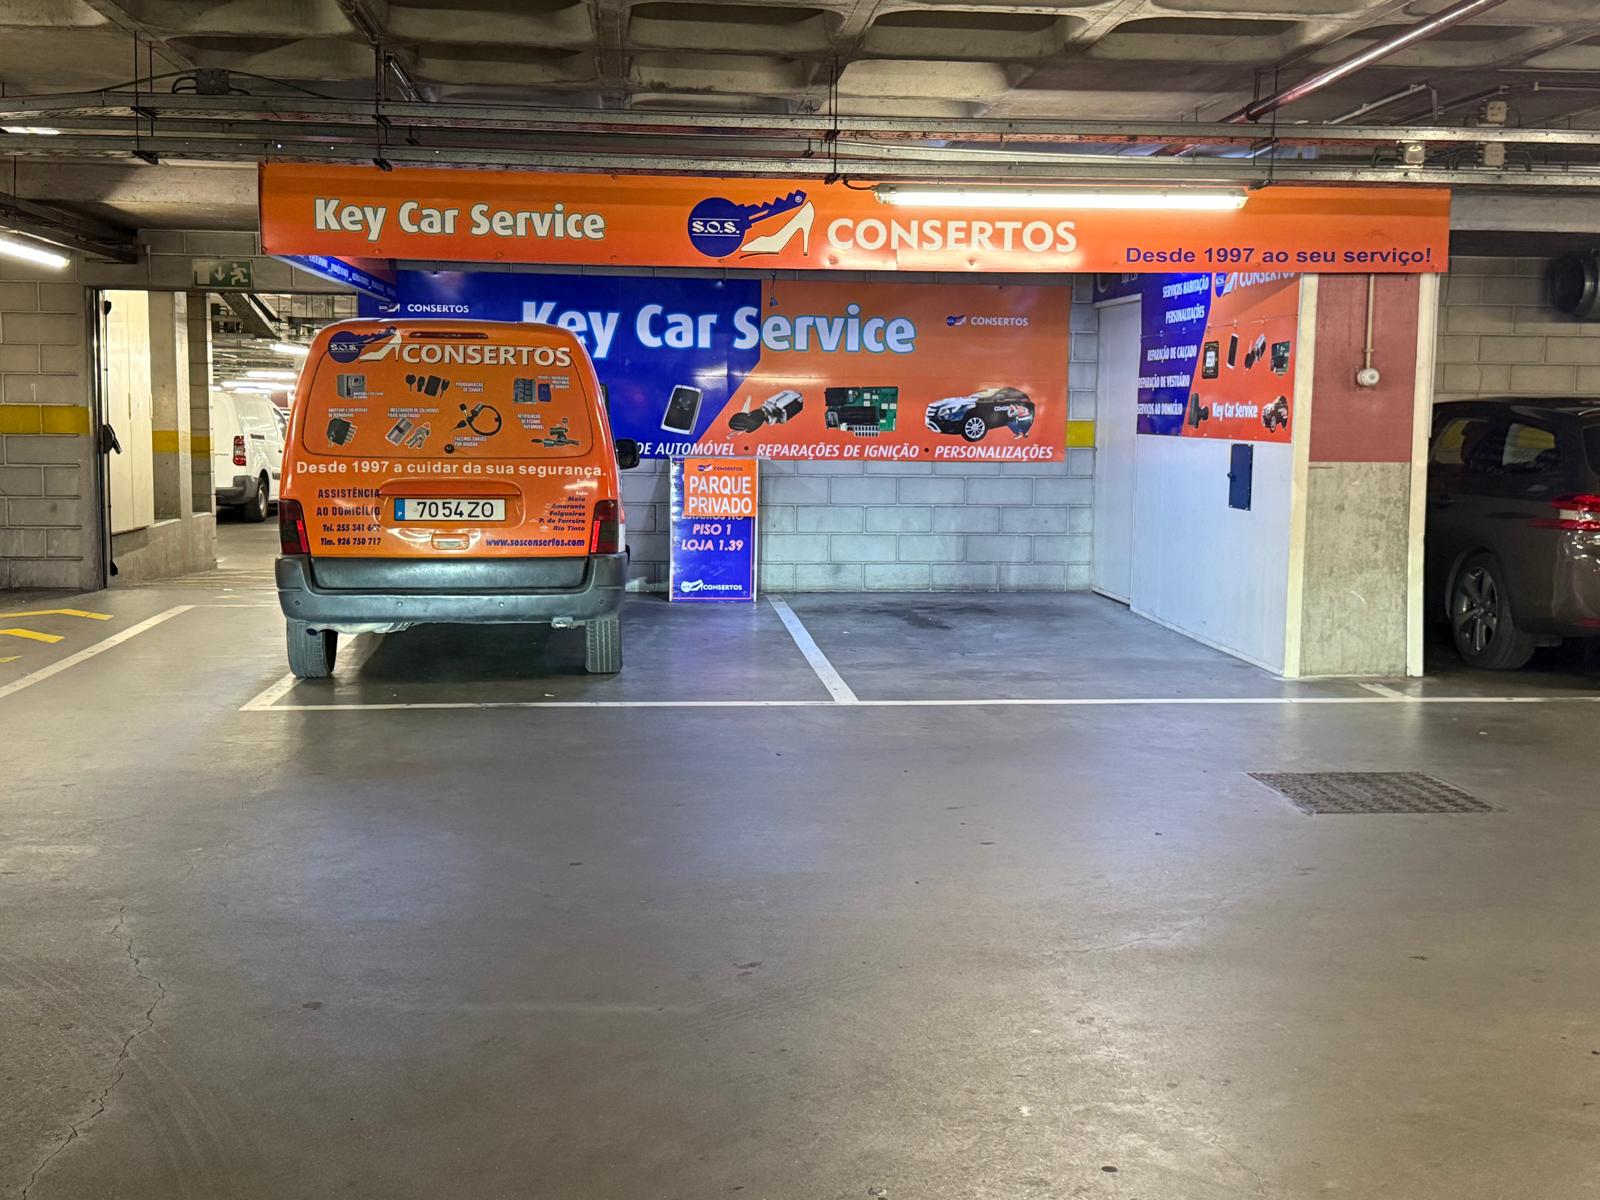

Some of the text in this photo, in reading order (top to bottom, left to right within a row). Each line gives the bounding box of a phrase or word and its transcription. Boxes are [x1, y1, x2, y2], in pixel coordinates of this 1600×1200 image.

[314, 198, 605, 241] Key Car Service
[691, 219, 740, 235] S.O.S.
[827, 218, 1077, 252] CONSERTOS
[1126, 247, 1432, 267] Desde 1997 ao seu serviço!
[1239, 272, 1295, 287] CONSER
[407, 303, 470, 313] CONSERTOS
[970, 316, 1029, 327] CONSERTOS
[521, 302, 917, 359] Key Car Service
[403, 344, 572, 367] CONSERTOS
[1170, 346, 1177, 359] DE
[1212, 400, 1259, 422] Key Car Service
[655, 440, 736, 456] AUTOMÓVEL
[756, 441, 1054, 461] REPARAÇÕES DE IGNIÇÃO PERSONALIZAÇÕES
[296, 460, 607, 478] Desde 1997 a cuidar da sua segurança.
[318, 486, 381, 498] ASSISTÊNCIA
[689, 475, 752, 495] PARQUE
[316, 507, 329, 517] AO
[688, 497, 752, 515] PRIVADO
[323, 524, 335, 533] Tel.
[337, 524, 350, 533] 255
[692, 523, 732, 536] PISO 1
[353, 537, 366, 546] 750
[368, 537, 381, 546] 717
[486, 538, 585, 547] www.sosconsertos.com
[681, 539, 744, 552] LOJA 1.39
[702, 583, 743, 592] CONSERTOS
